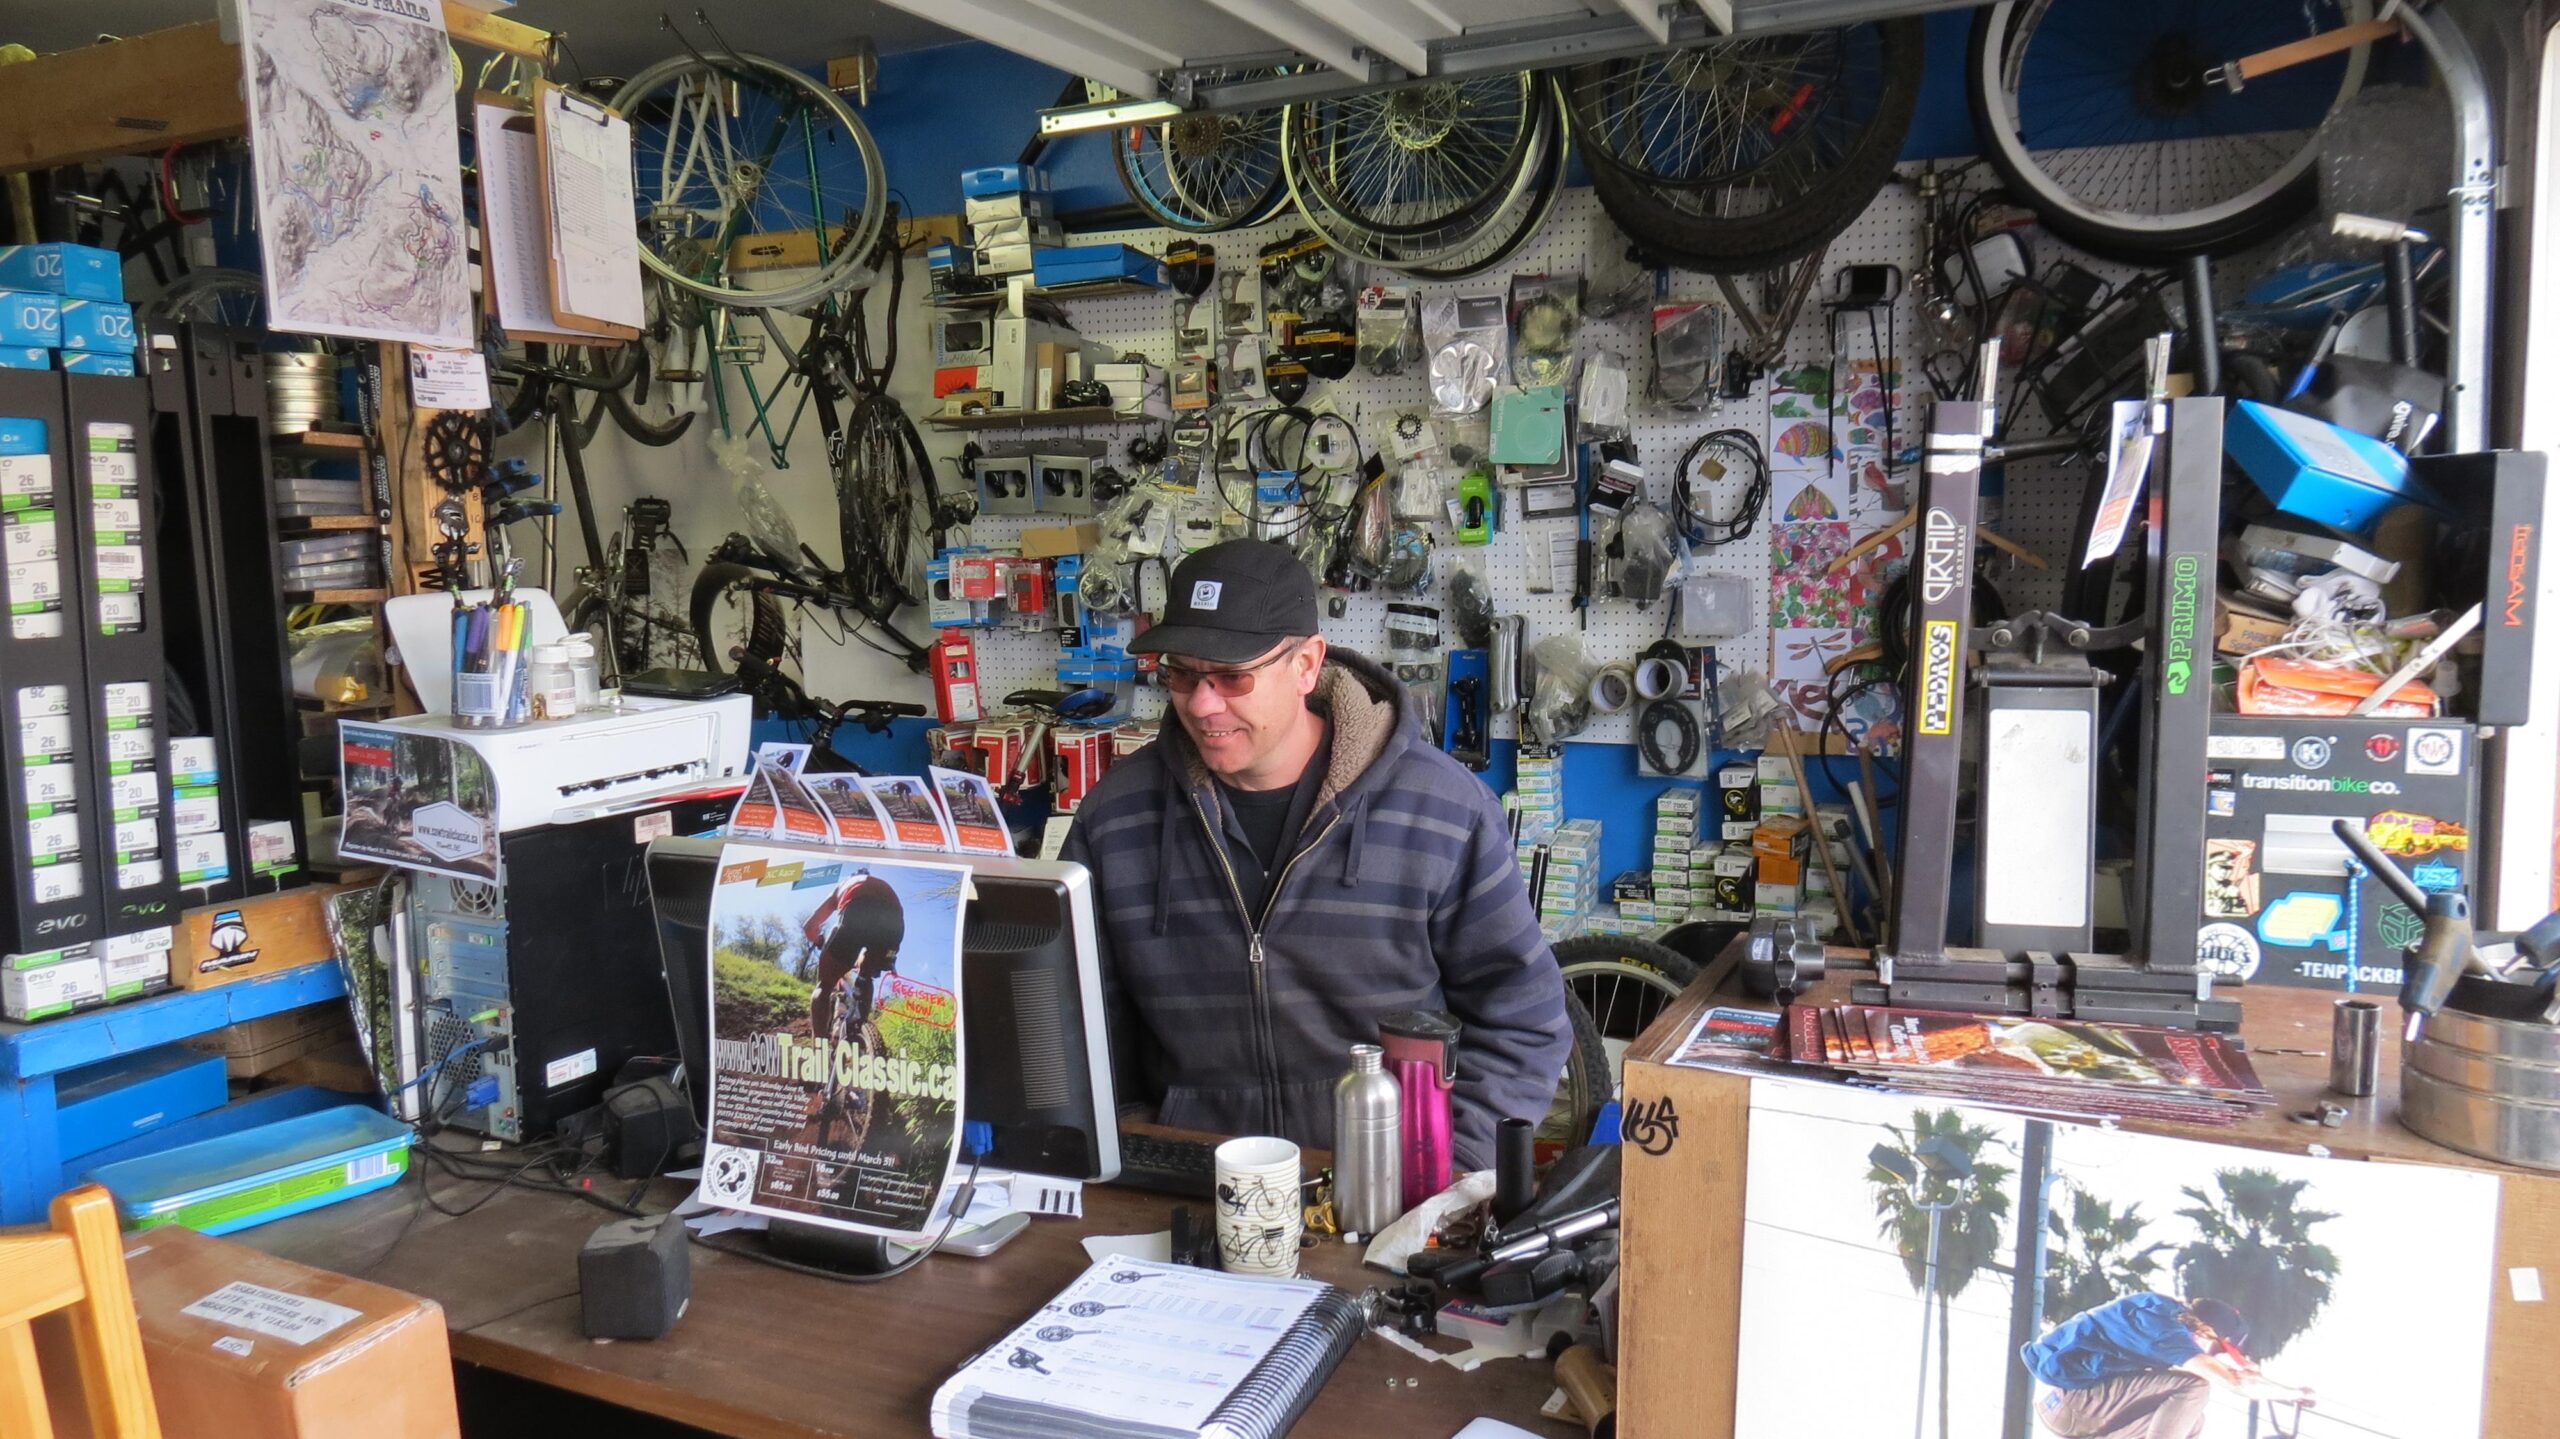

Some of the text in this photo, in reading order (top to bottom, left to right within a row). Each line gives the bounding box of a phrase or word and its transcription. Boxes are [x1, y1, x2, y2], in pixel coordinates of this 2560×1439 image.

[374, 0, 431, 22] TRAILS
[1925, 509, 1956, 603] ORCHID
[2170, 556, 2198, 660] PRIMO
[891, 981, 946, 1007] REGISTER
[905, 1002, 932, 1017] NOW
[774, 1139, 793, 1153] Early
[794, 1142, 810, 1153] Bird
[811, 1144, 837, 1160] Pricing
[838, 1147, 857, 1161] until
[858, 1151, 882, 1166] March
